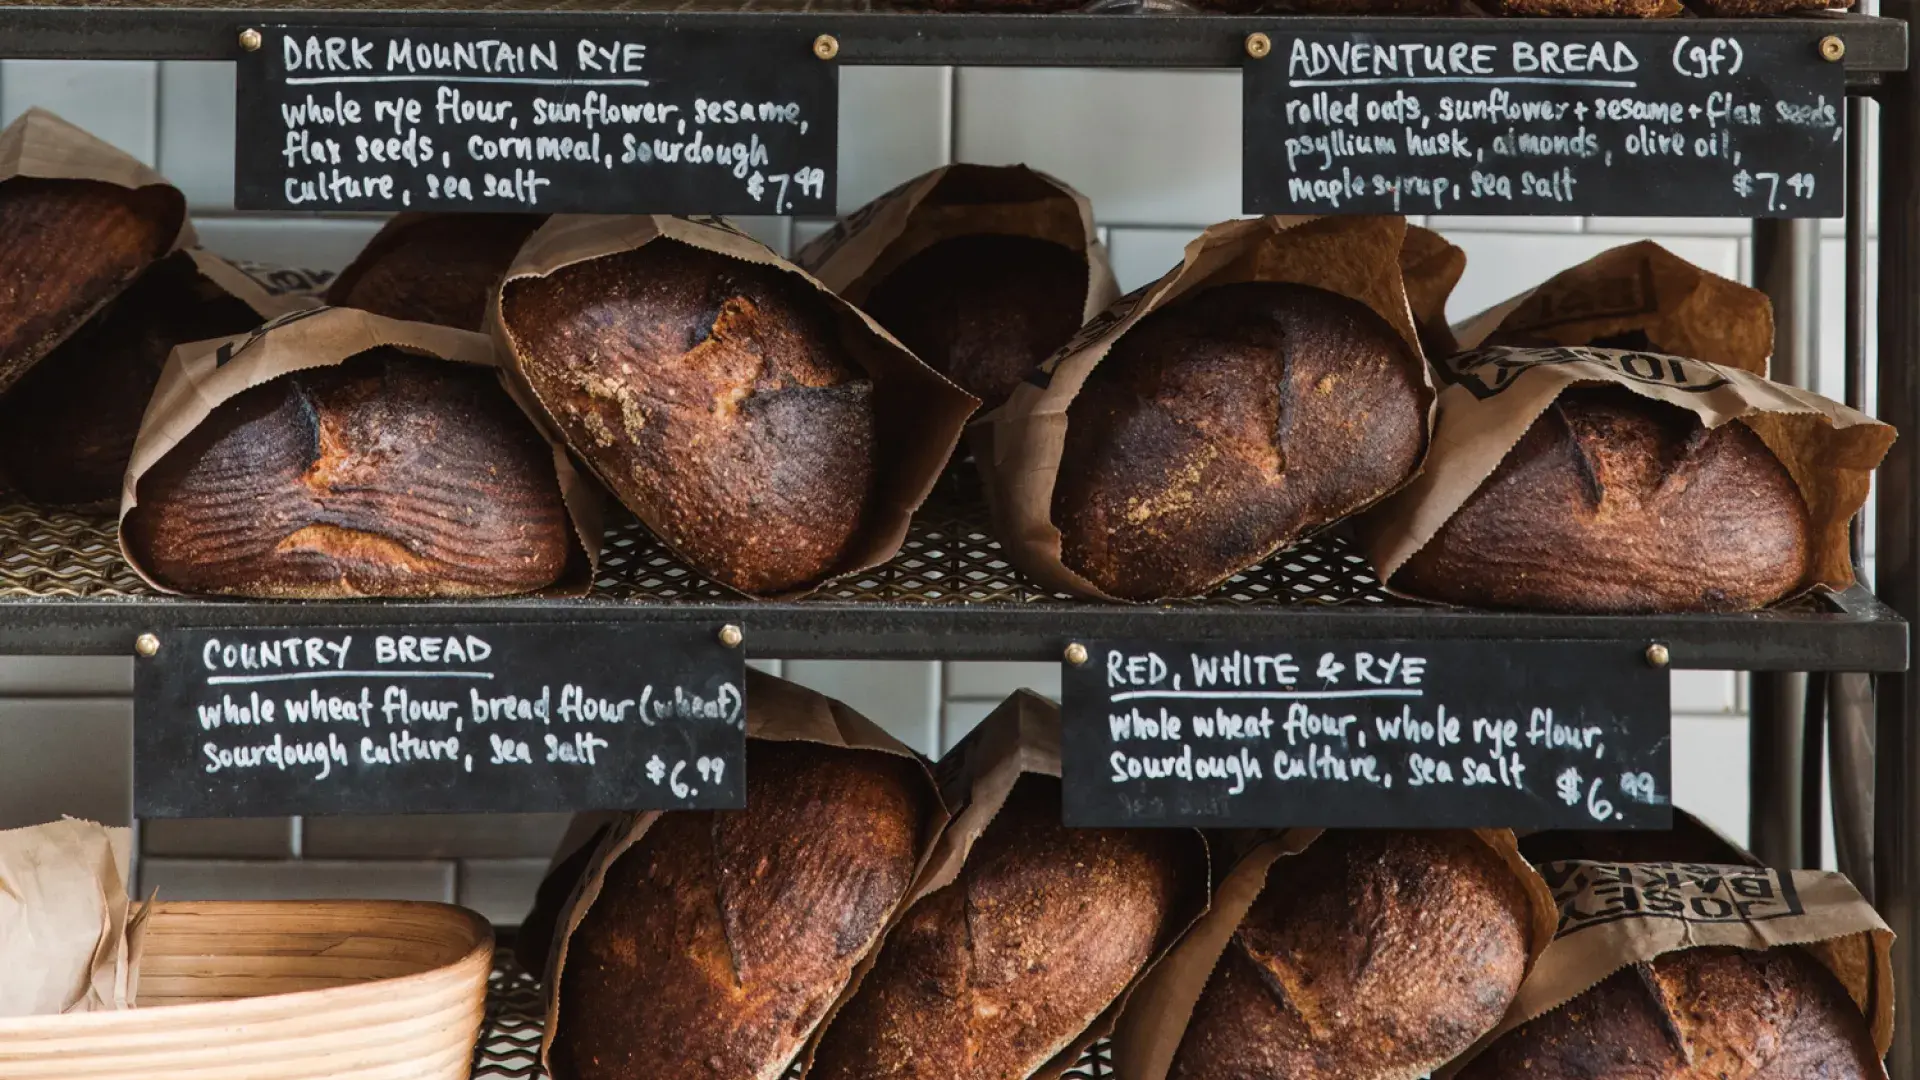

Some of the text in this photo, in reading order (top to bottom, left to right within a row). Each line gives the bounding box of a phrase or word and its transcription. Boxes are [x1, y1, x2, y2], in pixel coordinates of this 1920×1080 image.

[284, 37, 646, 73] DARK MOUNTAIN RYE
[1289, 36, 1743, 78] ADVENTURE BREAD (gf)
[282, 86, 808, 139] whole rye flour, sunflower, sesame,
[1286, 92, 1358, 126] rolled
[1367, 90, 1430, 129] oats,
[1439, 88, 1569, 124] sunflower
[1595, 98, 1683, 124] sesame
[1706, 91, 1760, 126] flax
[282, 132, 768, 180] flax seeds, cornmeal, sourdough
[1285, 127, 1741, 172] psyllium husk, almonds, olive oil,
[285, 170, 550, 206] culture, sea salt
[746, 167, 824, 214] $7.49
[1288, 173, 1577, 211] maple syrup, sea salt
[1733, 169, 1815, 211] $7.49
[203, 635, 492, 671] COUNTRY BREAD
[1107, 650, 1426, 690] RED, WHITE & RYE
[198, 691, 275, 730] whole
[287, 690, 373, 724] wheat
[381, 685, 462, 732] flour,
[471, 685, 550, 723] bread
[557, 684, 635, 723] flour
[1109, 703, 1604, 761] whole wheat flour, whole rye flour,
[203, 733, 608, 780] sourdough culture, sea salt
[645, 755, 725, 799] $6.99
[1110, 745, 1525, 795] sourdough culture, sea salt
